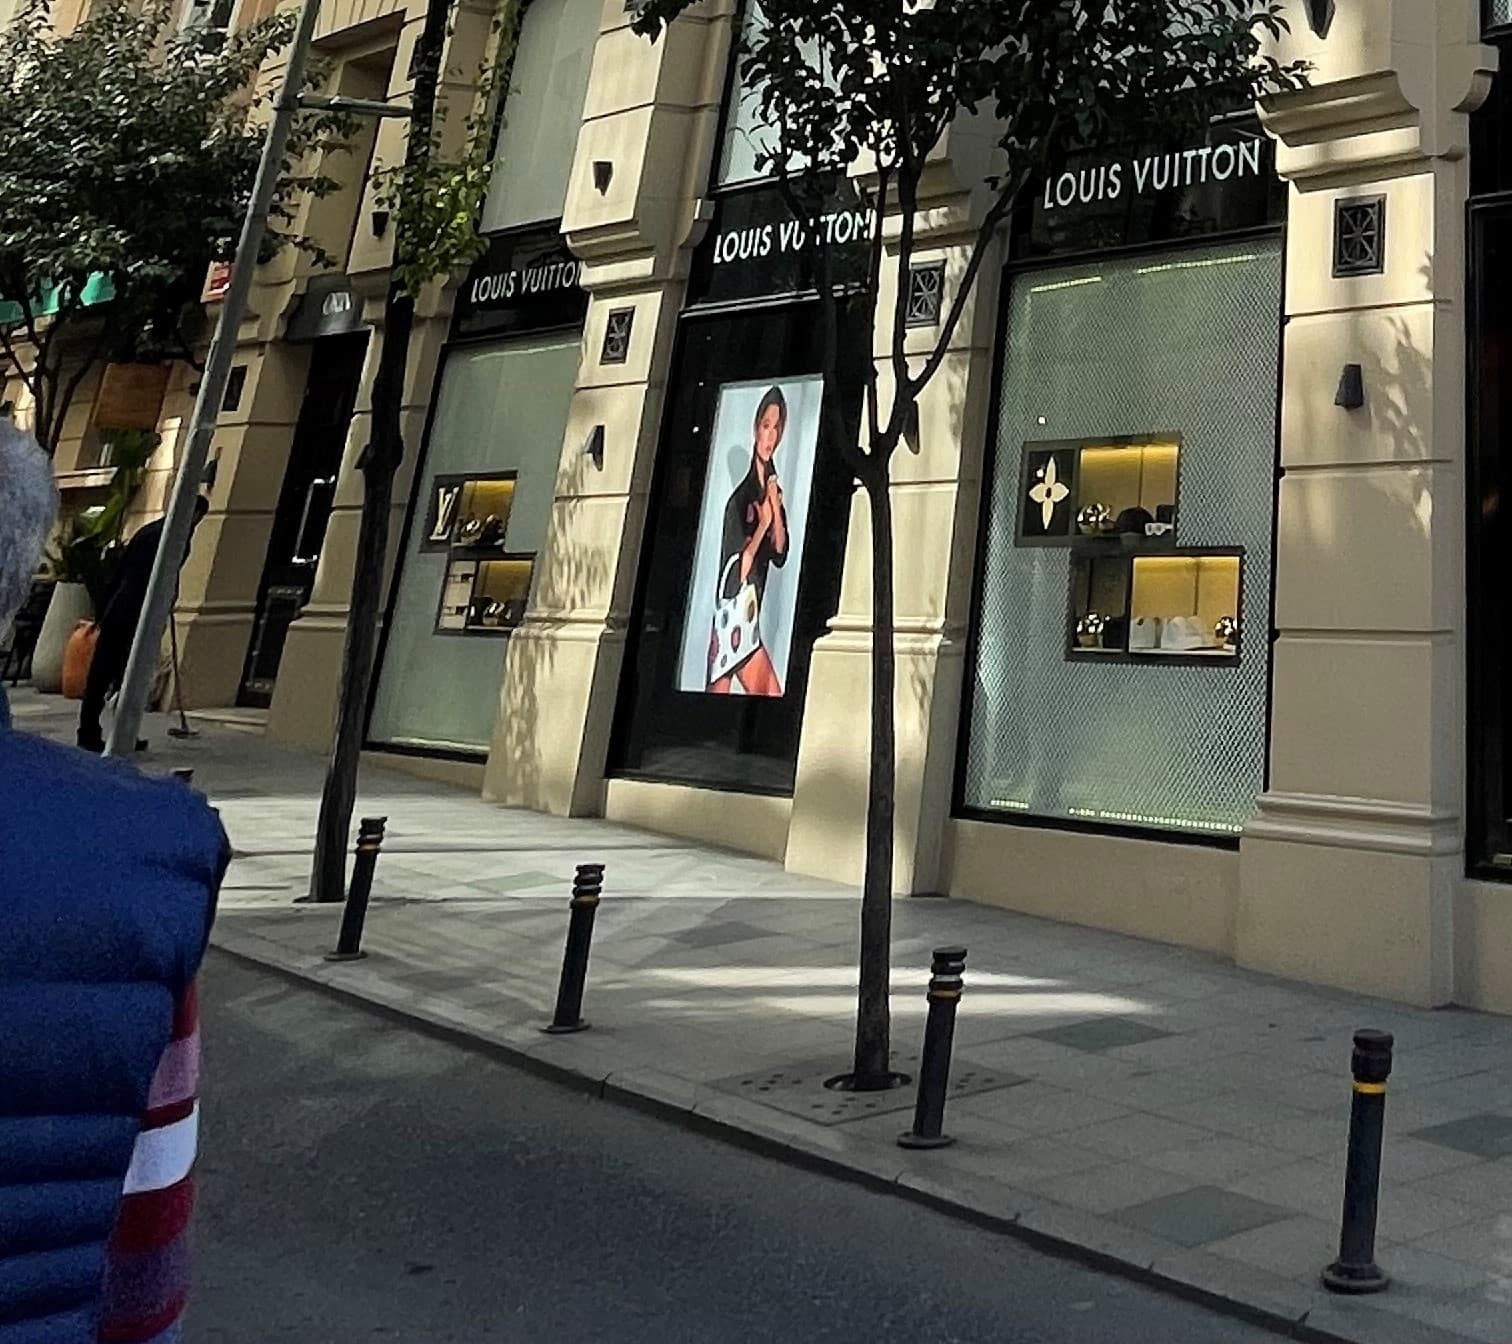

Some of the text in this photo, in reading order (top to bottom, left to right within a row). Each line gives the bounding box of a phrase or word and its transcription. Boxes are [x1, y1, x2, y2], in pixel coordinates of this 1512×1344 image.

[1043, 138, 1261, 210] LOUIS VUITTON
[712, 208, 874, 264] LOUIS VUTON
[470, 270, 517, 304] LOUIS
